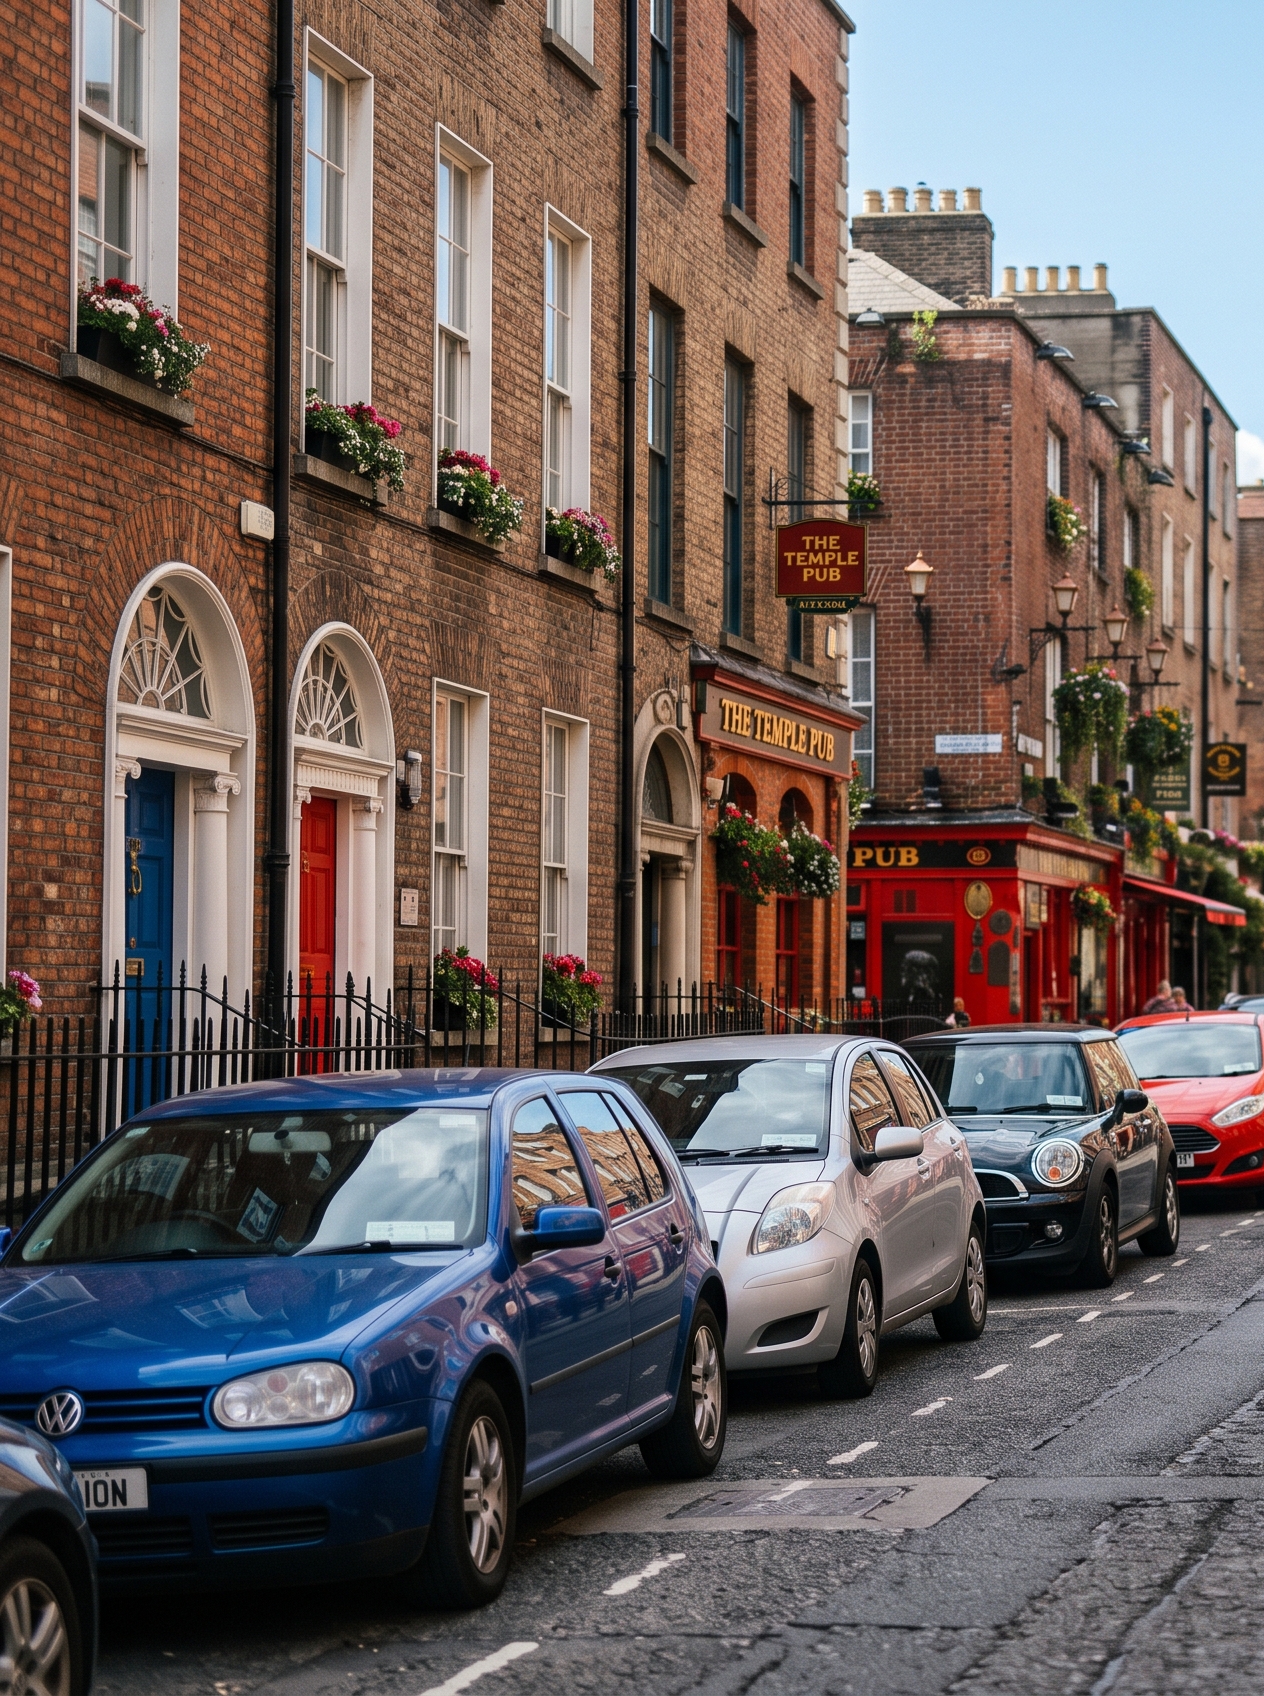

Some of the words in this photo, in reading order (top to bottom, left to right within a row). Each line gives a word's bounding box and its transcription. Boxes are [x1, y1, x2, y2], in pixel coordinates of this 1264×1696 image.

[802, 535, 840, 549] THE
[783, 551, 859, 566] TEMPLE
[803, 567, 841, 582] PUB
[721, 698, 752, 738] THE
[754, 708, 807, 755] TEMPLE
[808, 727, 835, 763] PUB
[852, 846, 920, 868] PUB
